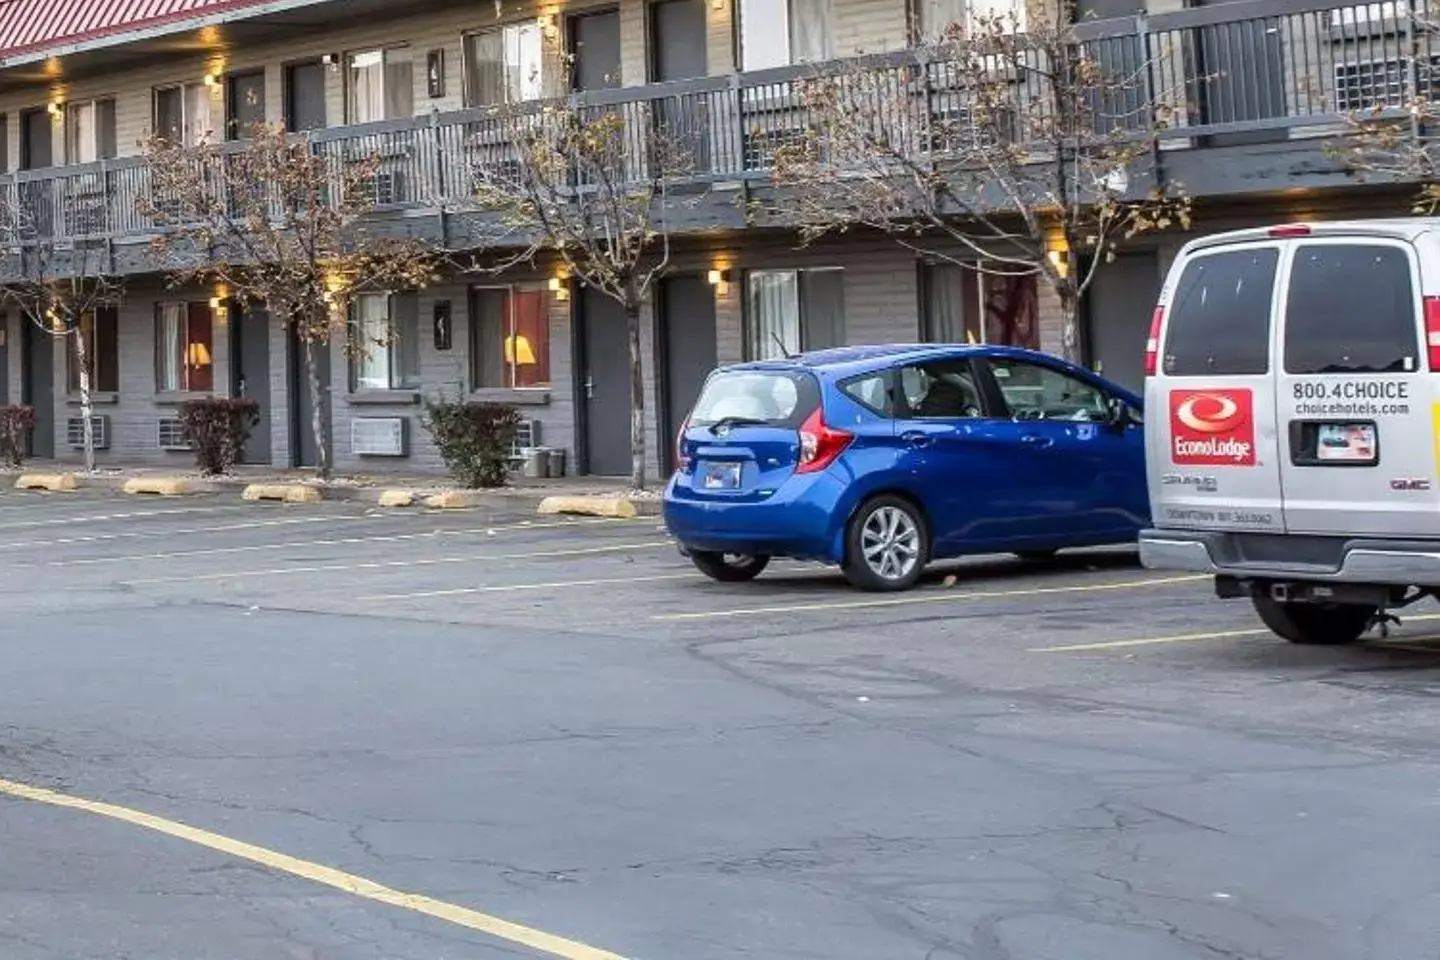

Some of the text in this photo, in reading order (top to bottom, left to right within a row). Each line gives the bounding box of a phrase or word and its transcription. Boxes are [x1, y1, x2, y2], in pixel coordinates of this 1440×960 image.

[1293, 382, 1409, 399] 800.4CHOICE
[1295, 401, 1409, 415] choicehotels.com
[1175, 436, 1251, 461] EconoLodge
[1390, 480, 1431, 490] GMC
